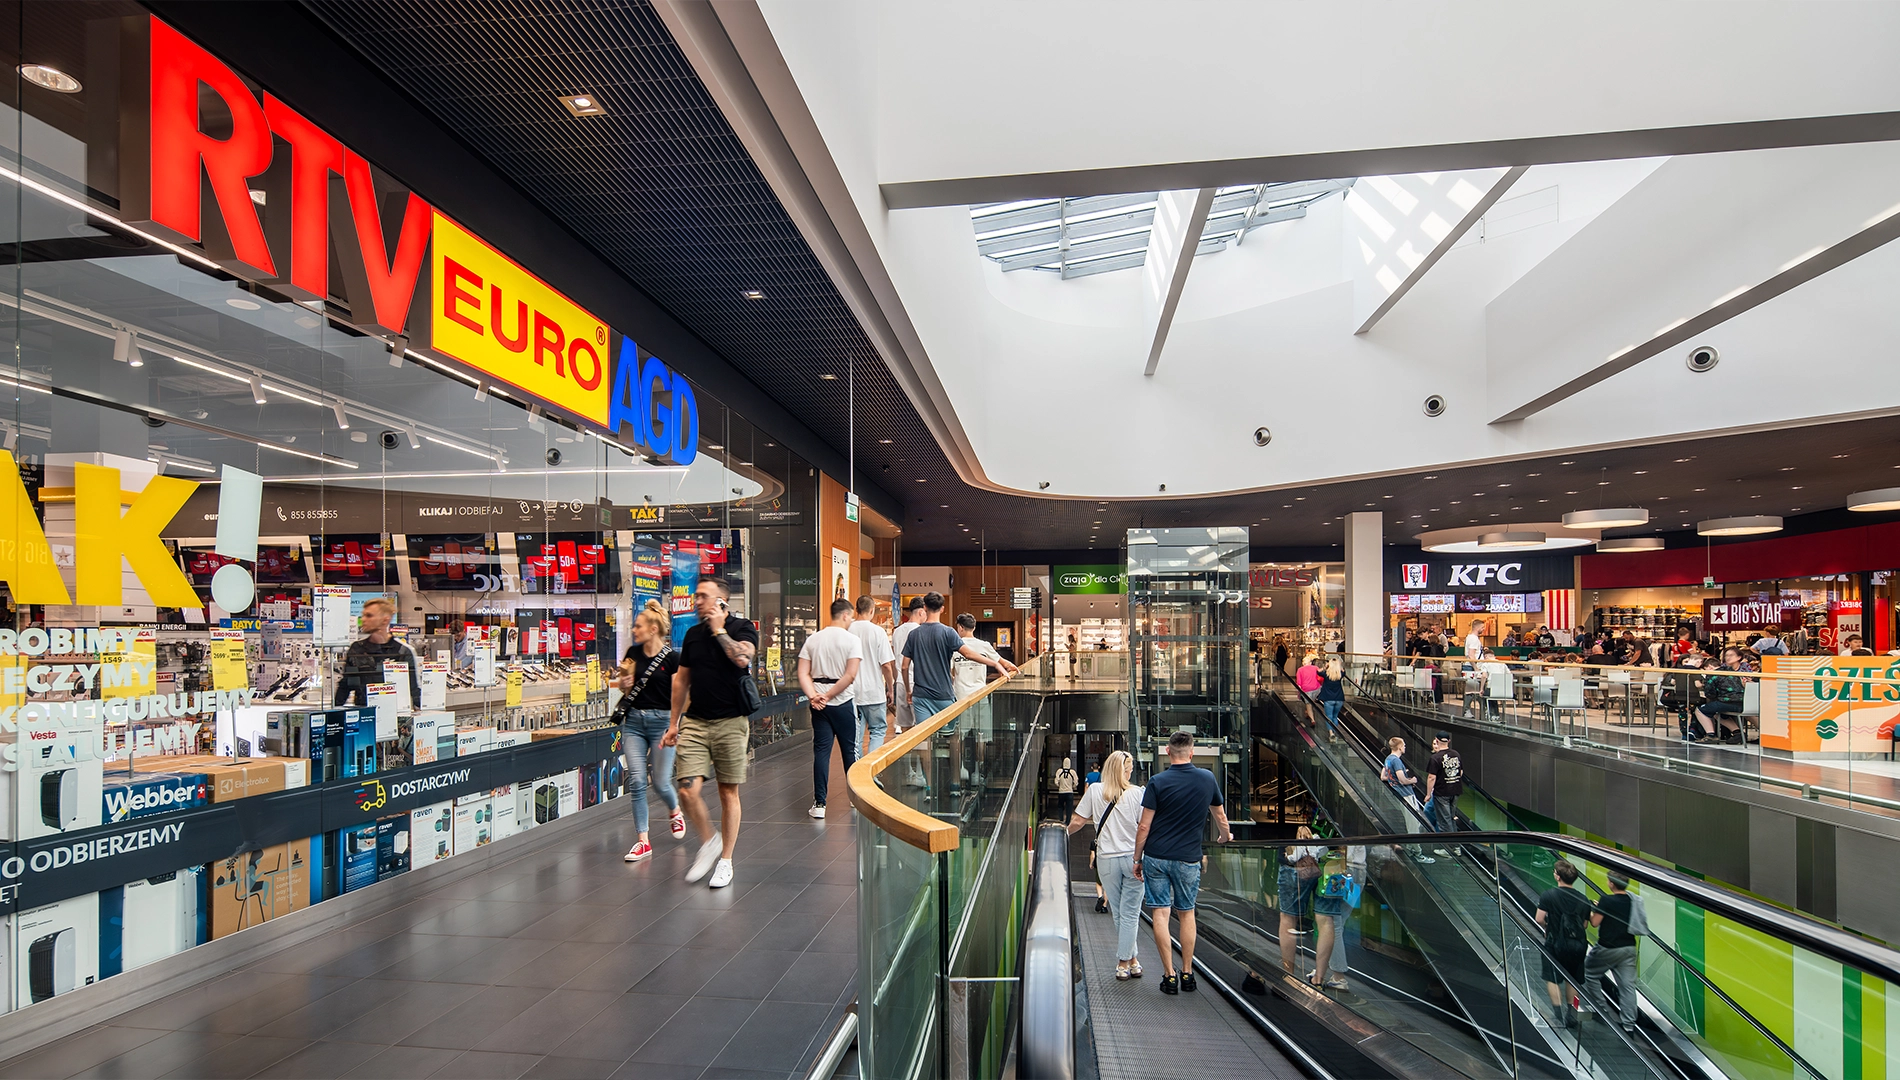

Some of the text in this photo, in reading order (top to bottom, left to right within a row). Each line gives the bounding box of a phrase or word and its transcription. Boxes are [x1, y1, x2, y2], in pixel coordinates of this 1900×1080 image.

[150, 14, 433, 335] RTV
[611, 336, 699, 466] AGD
[290, 509, 338, 520] 855 855 855
[419, 507, 453, 517] KLIKAJ
[459, 505, 503, 516] ODBIERAJ
[629, 506, 665, 523] TAK!
[1064, 576, 1087, 585] ziaja
[1094, 573, 1108, 583] dla
[1447, 562, 1522, 586] KFC
[900, 580, 934, 588] OKOLEŃ
[1422, 603, 1453, 611] ODBIERZ
[1485, 602, 1517, 611] ZAMÓW
[1731, 602, 1782, 625] BIG STAR
[231, 620, 254, 630] RATY
[1840, 624, 1860, 632] SALE
[0, 627, 142, 656] ROBIMY
[103, 656, 123, 664] 1549
[4, 661, 156, 695] ECZYMY
[1813, 658, 1900, 702] CZEŚ
[0, 687, 258, 733] KONFIGURUJEMY
[415, 720, 435, 728] raven
[30, 730, 57, 741] Vesta
[459, 735, 477, 745] raven
[1, 722, 203, 772] STALUJEMY
[497, 737, 516, 748] raven
[391, 768, 471, 799] DOSTARCZYMY
[104, 784, 196, 816] Webber
[413, 807, 433, 818] raven
[378, 822, 393, 831] raven
[30, 821, 186, 873] ODBIERZEMY
